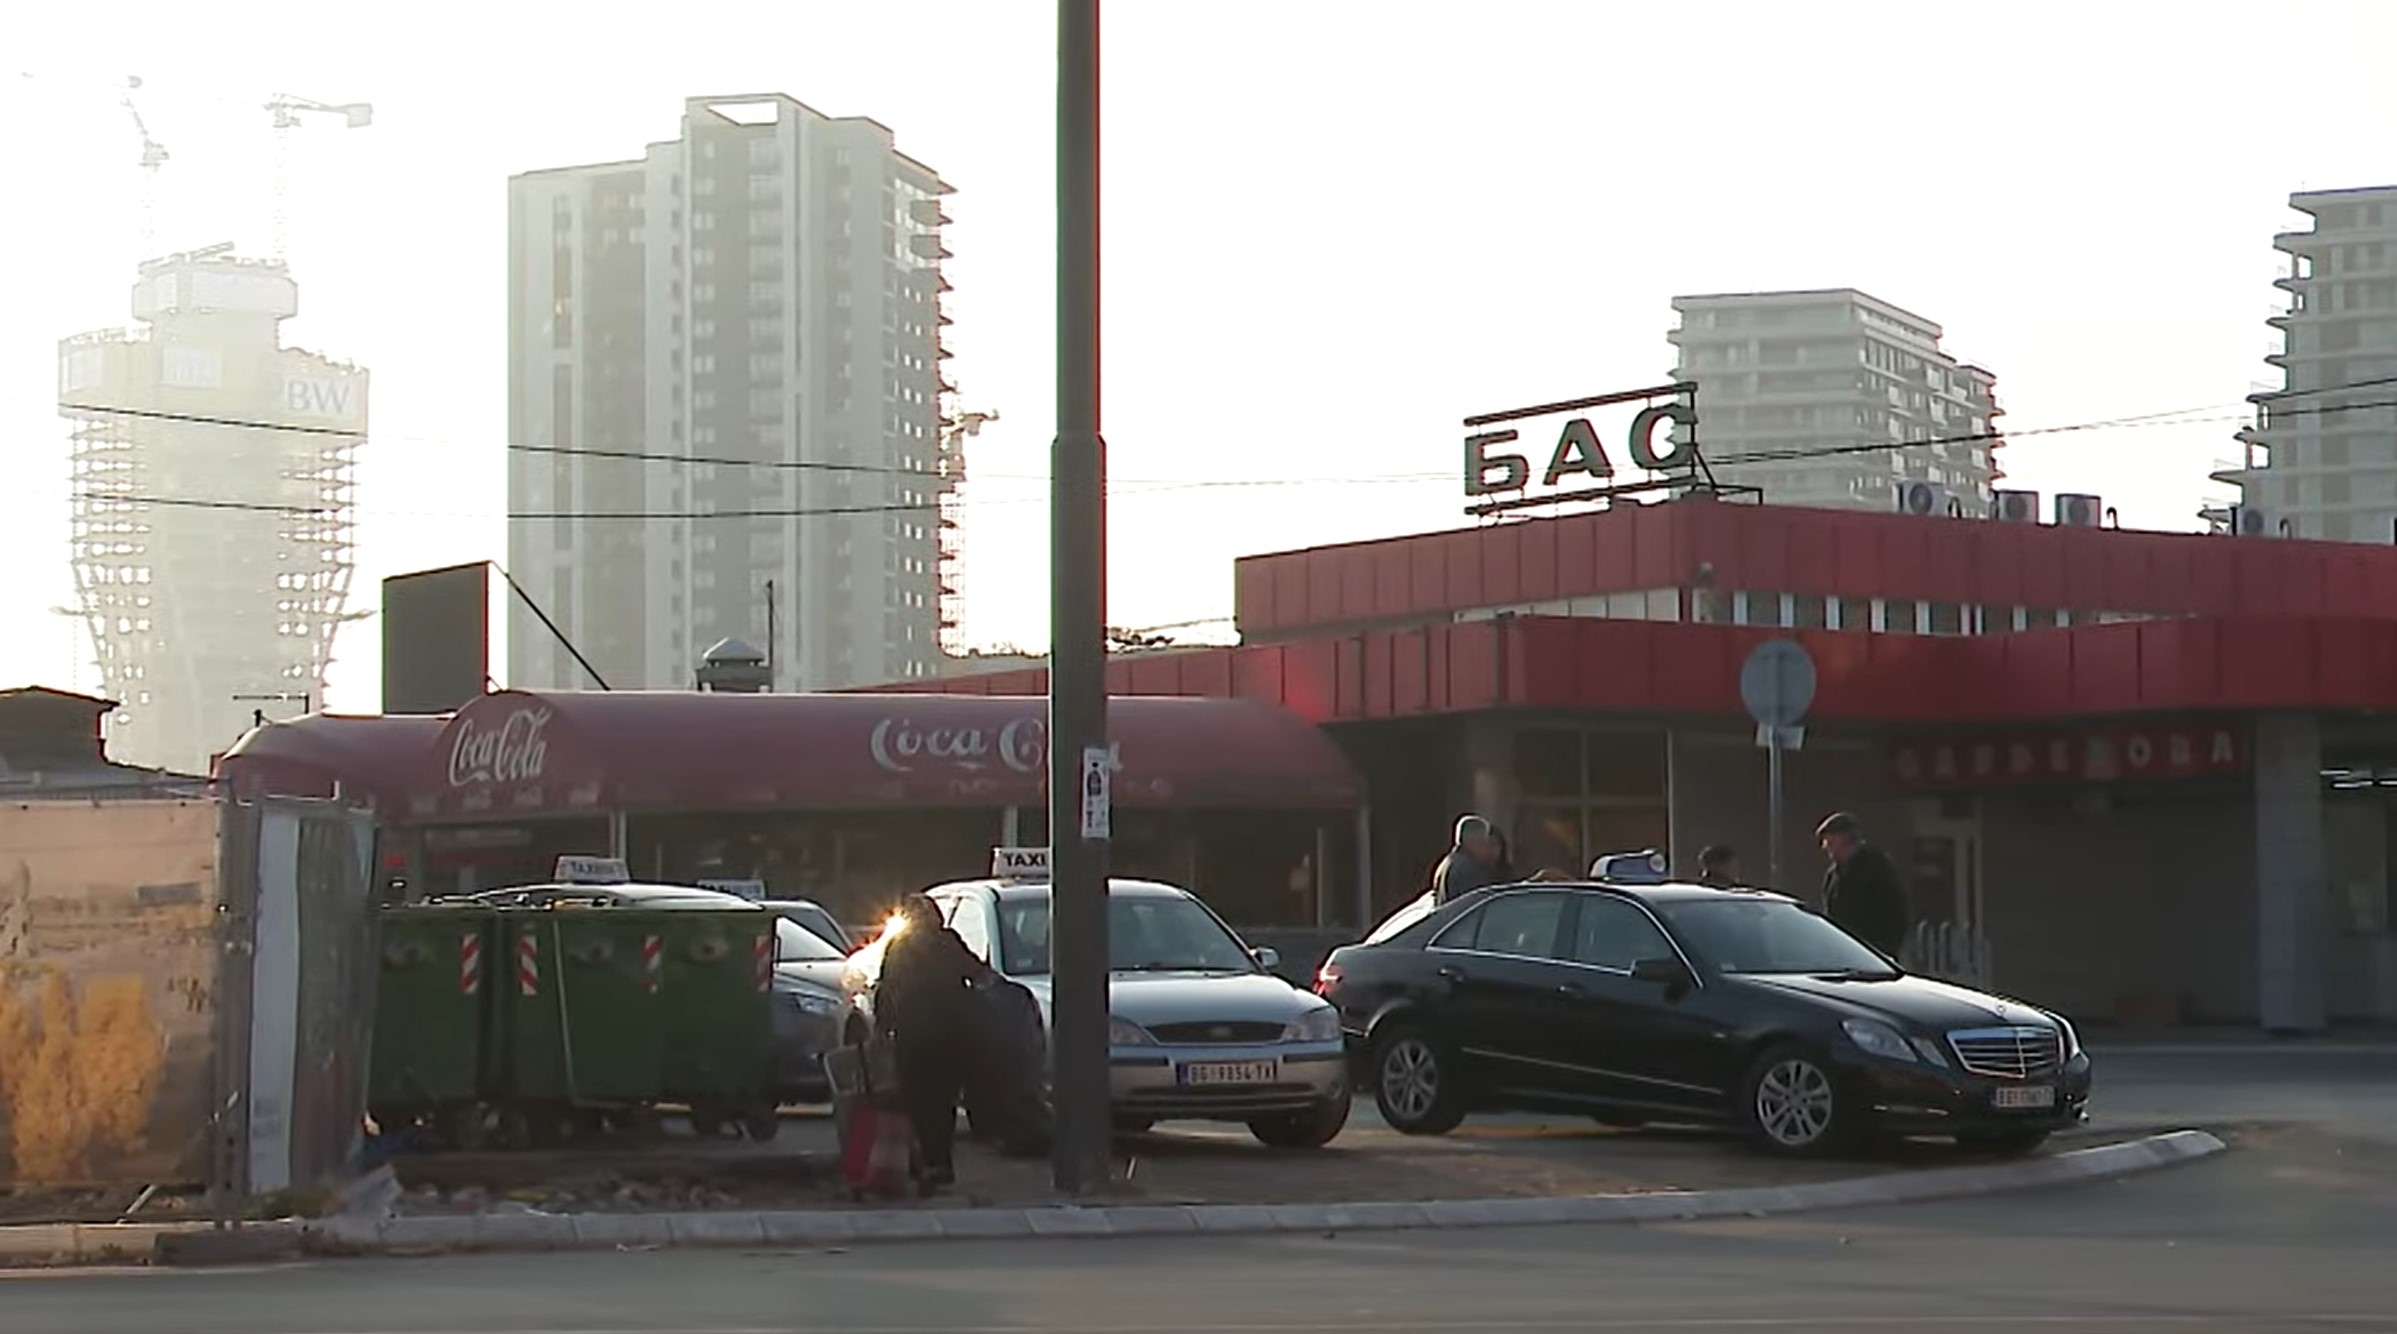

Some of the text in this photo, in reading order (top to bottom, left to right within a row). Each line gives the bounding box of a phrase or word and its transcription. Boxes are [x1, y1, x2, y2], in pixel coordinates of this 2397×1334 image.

[288, 379, 350, 414] BW
[1464, 403, 1698, 495] БАС
[871, 718, 987, 771] Coca
[1003, 853, 1046, 867] TAXI
